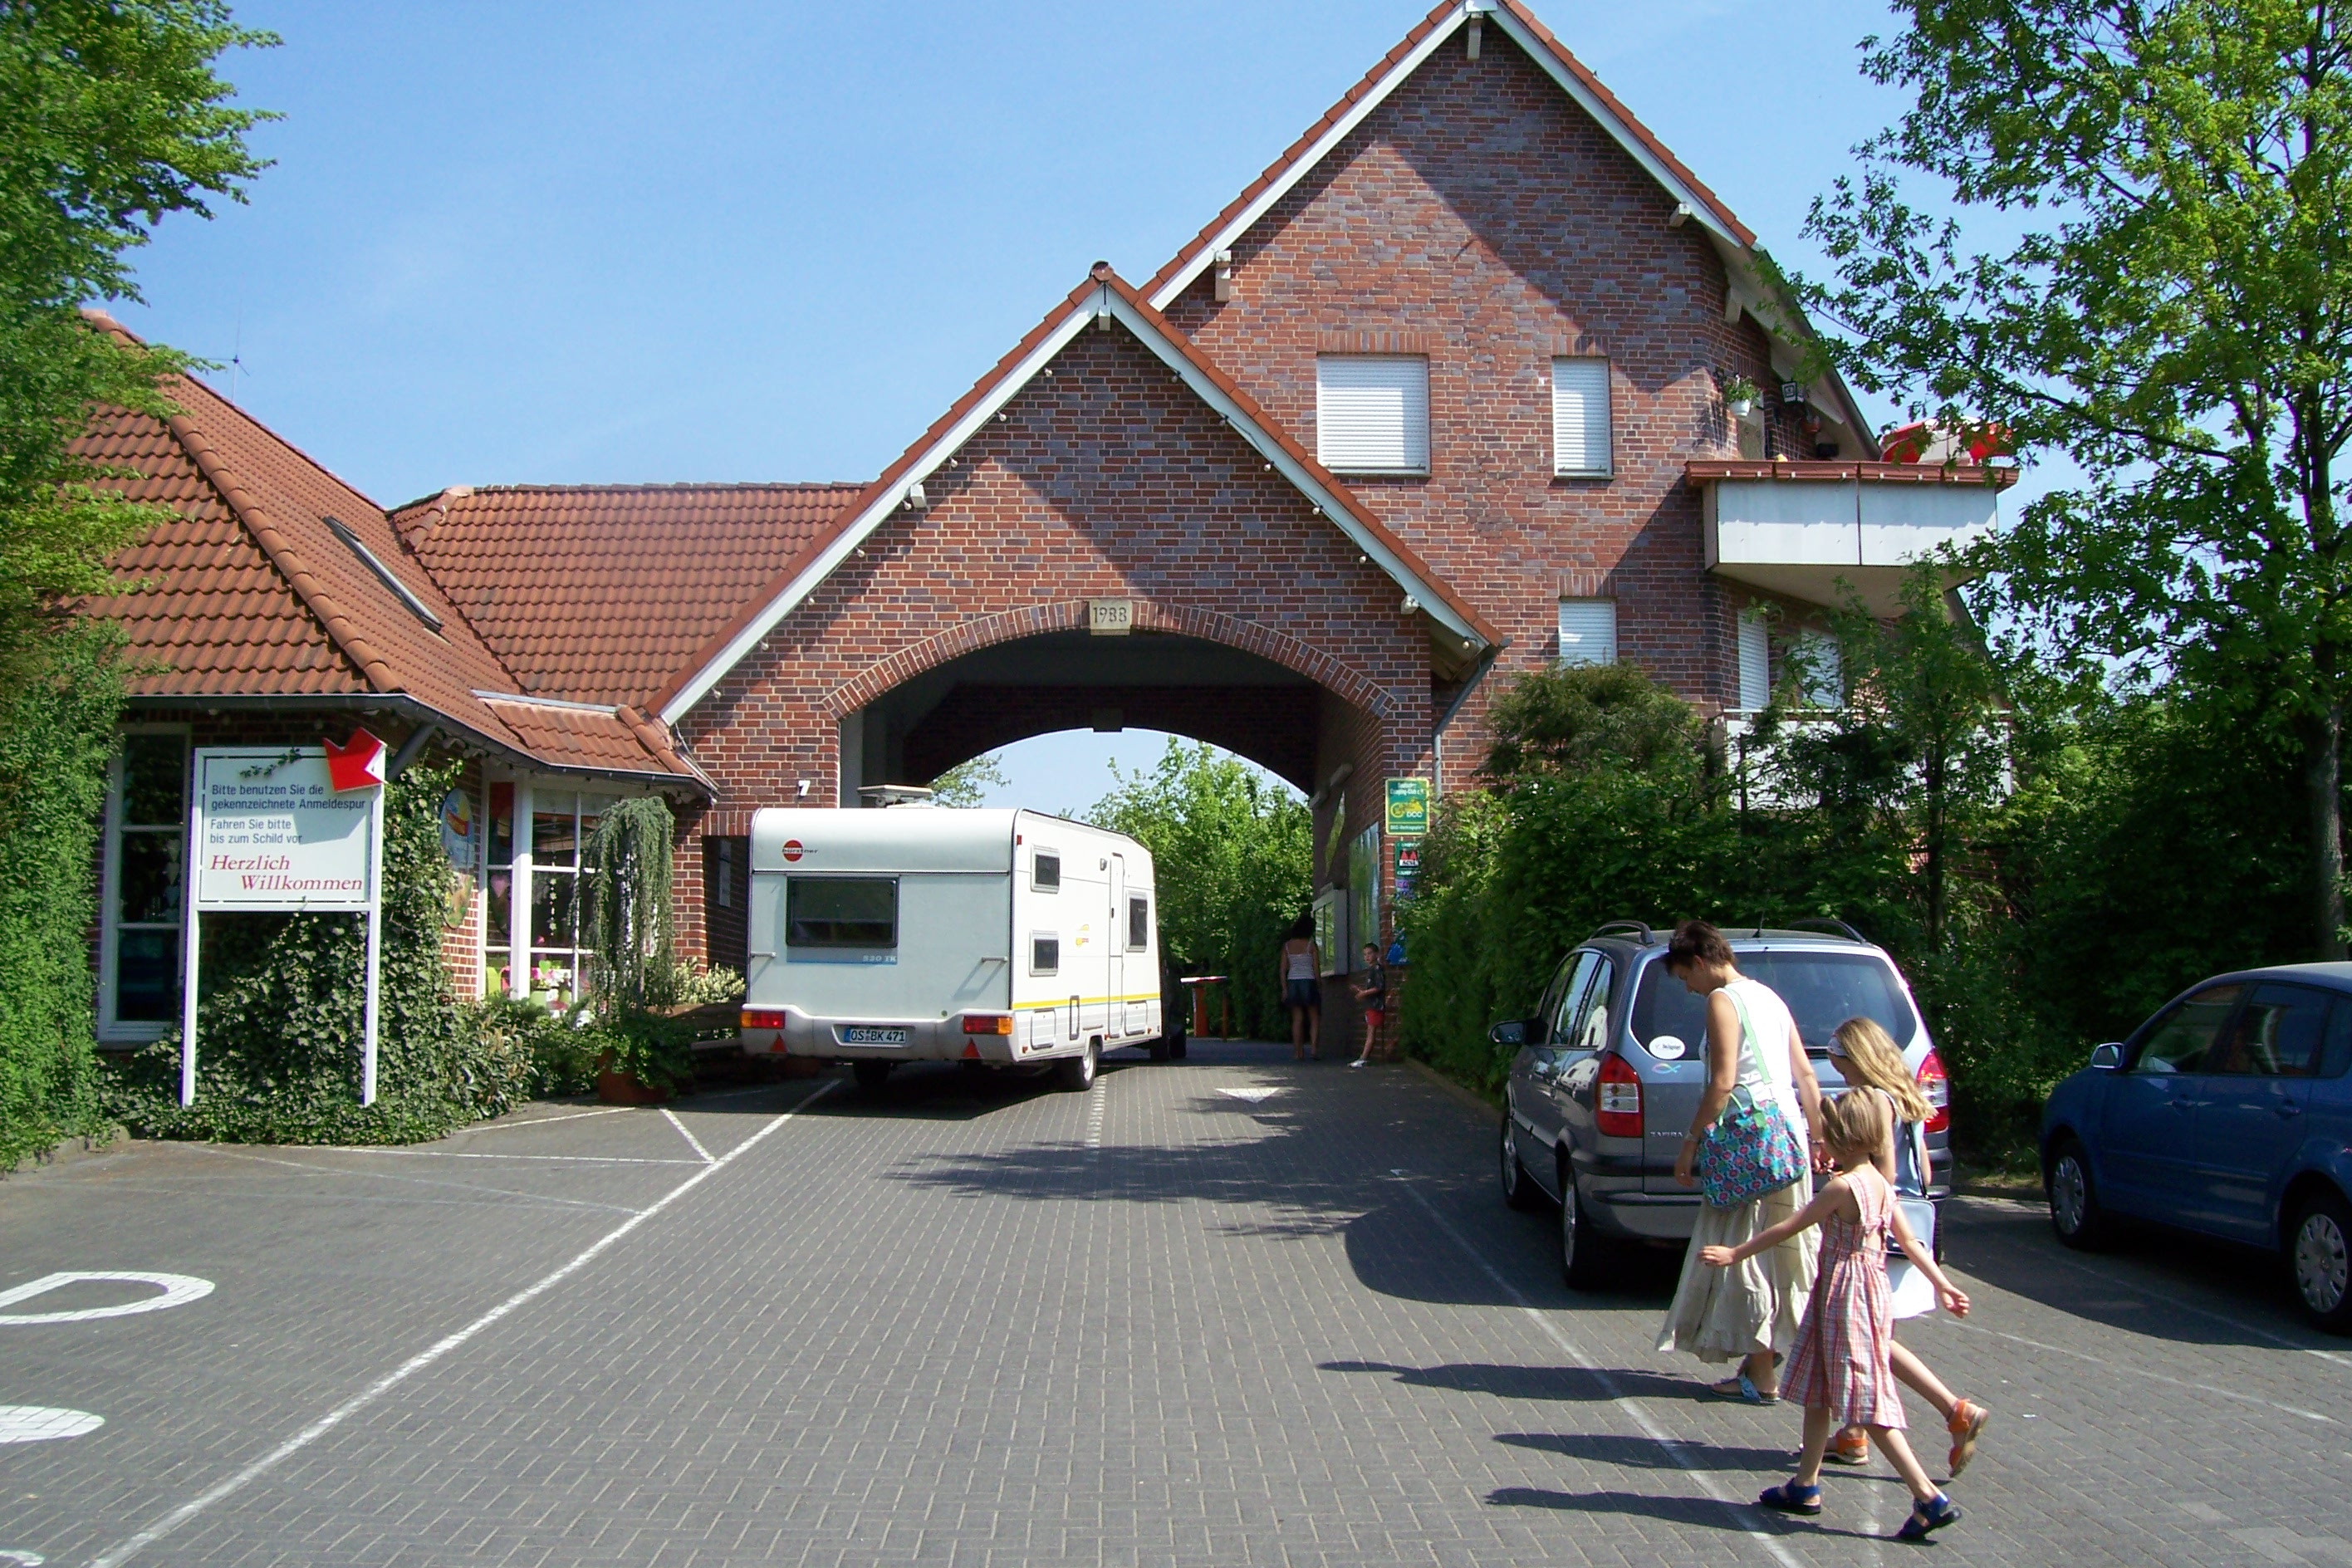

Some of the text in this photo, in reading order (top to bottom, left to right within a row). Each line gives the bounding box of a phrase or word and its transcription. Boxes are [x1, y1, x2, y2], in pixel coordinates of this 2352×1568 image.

[1093, 607, 1127, 623] 1988
[212, 785, 324, 795] Bitte benutzen Sie die
[211, 799, 365, 811] gekennzeichnete Anmeldespur
[210, 818, 291, 830] Fahren Sie bitte
[210, 833, 302, 844] bis zum Schild vor
[210, 855, 290, 870] Herzlich
[241, 875, 363, 891] Willkommen
[850, 1030, 904, 1041] OS BK 471
